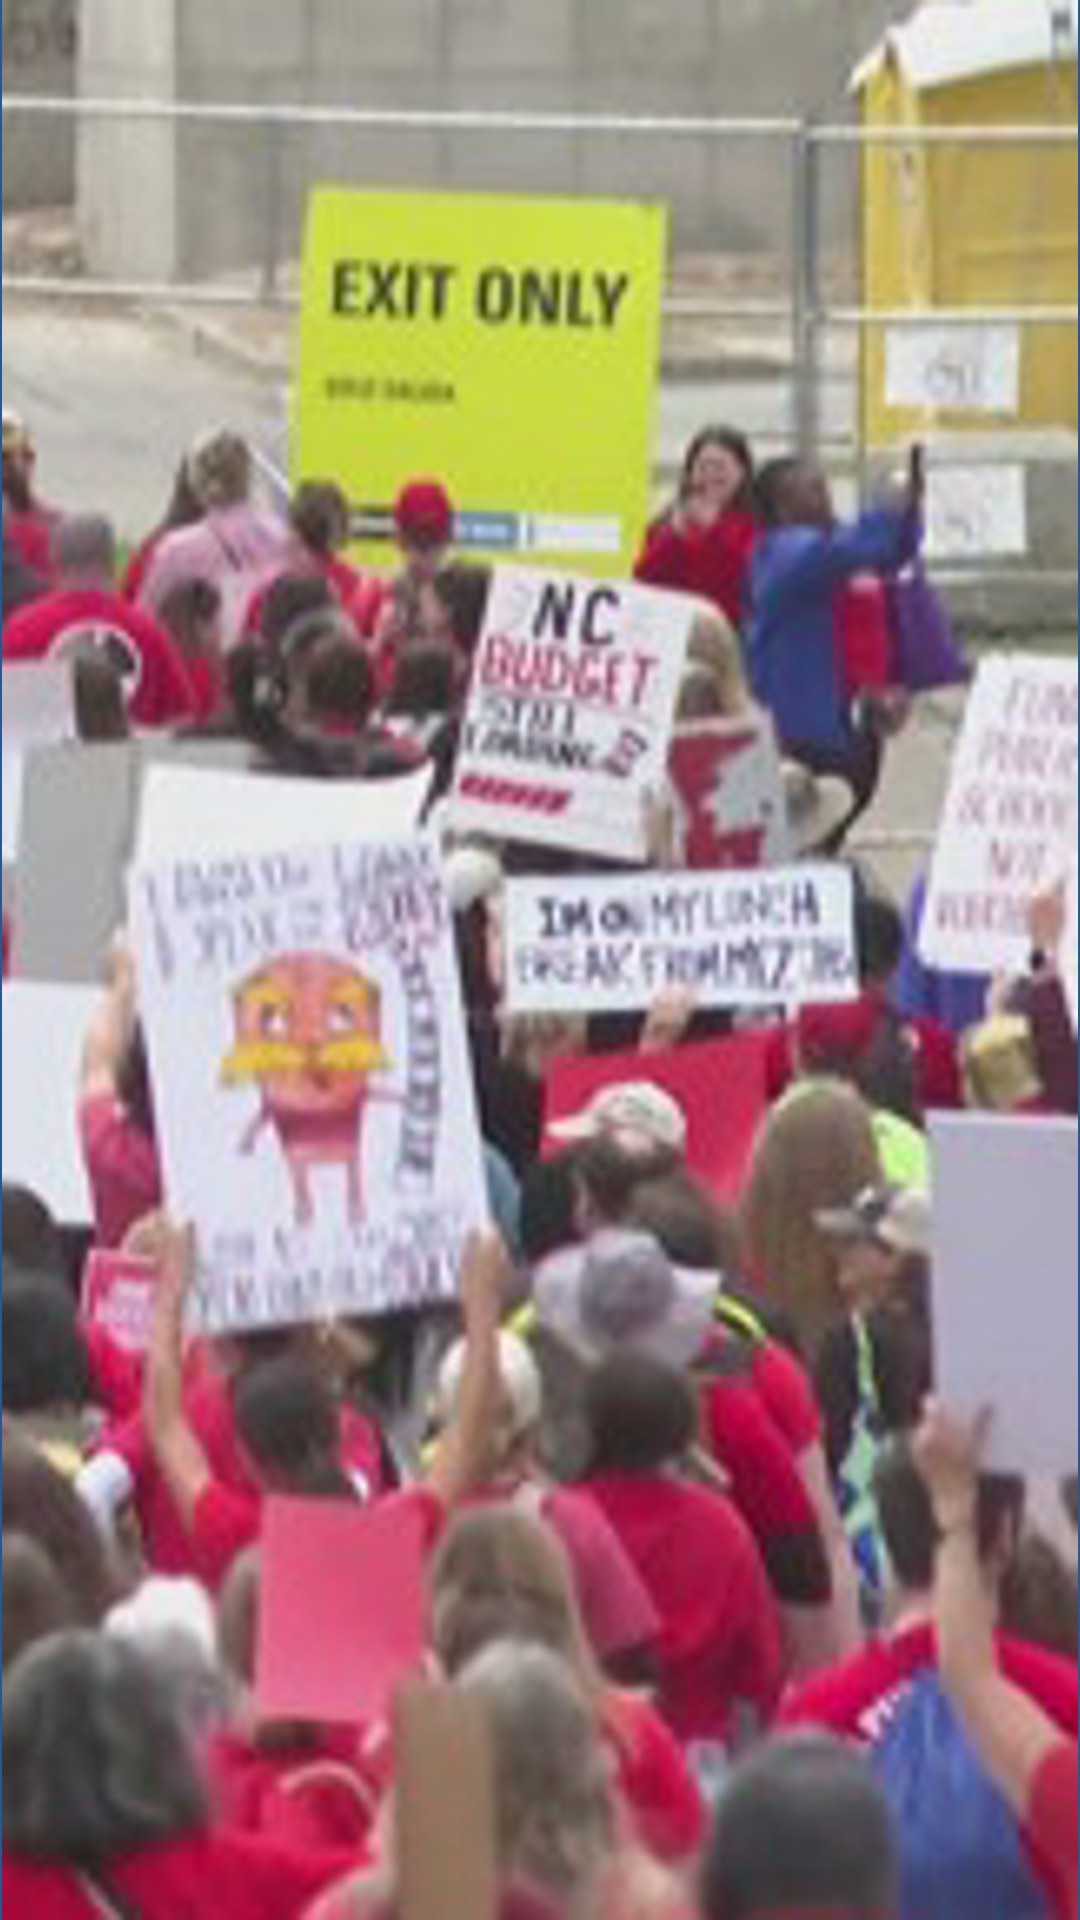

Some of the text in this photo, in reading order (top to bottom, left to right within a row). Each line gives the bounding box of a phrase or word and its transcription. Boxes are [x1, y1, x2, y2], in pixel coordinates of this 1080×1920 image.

[332, 259, 628, 326] EXIT ONLY
[533, 582, 620, 645] NC
[481, 636, 659, 706] BUDGET
